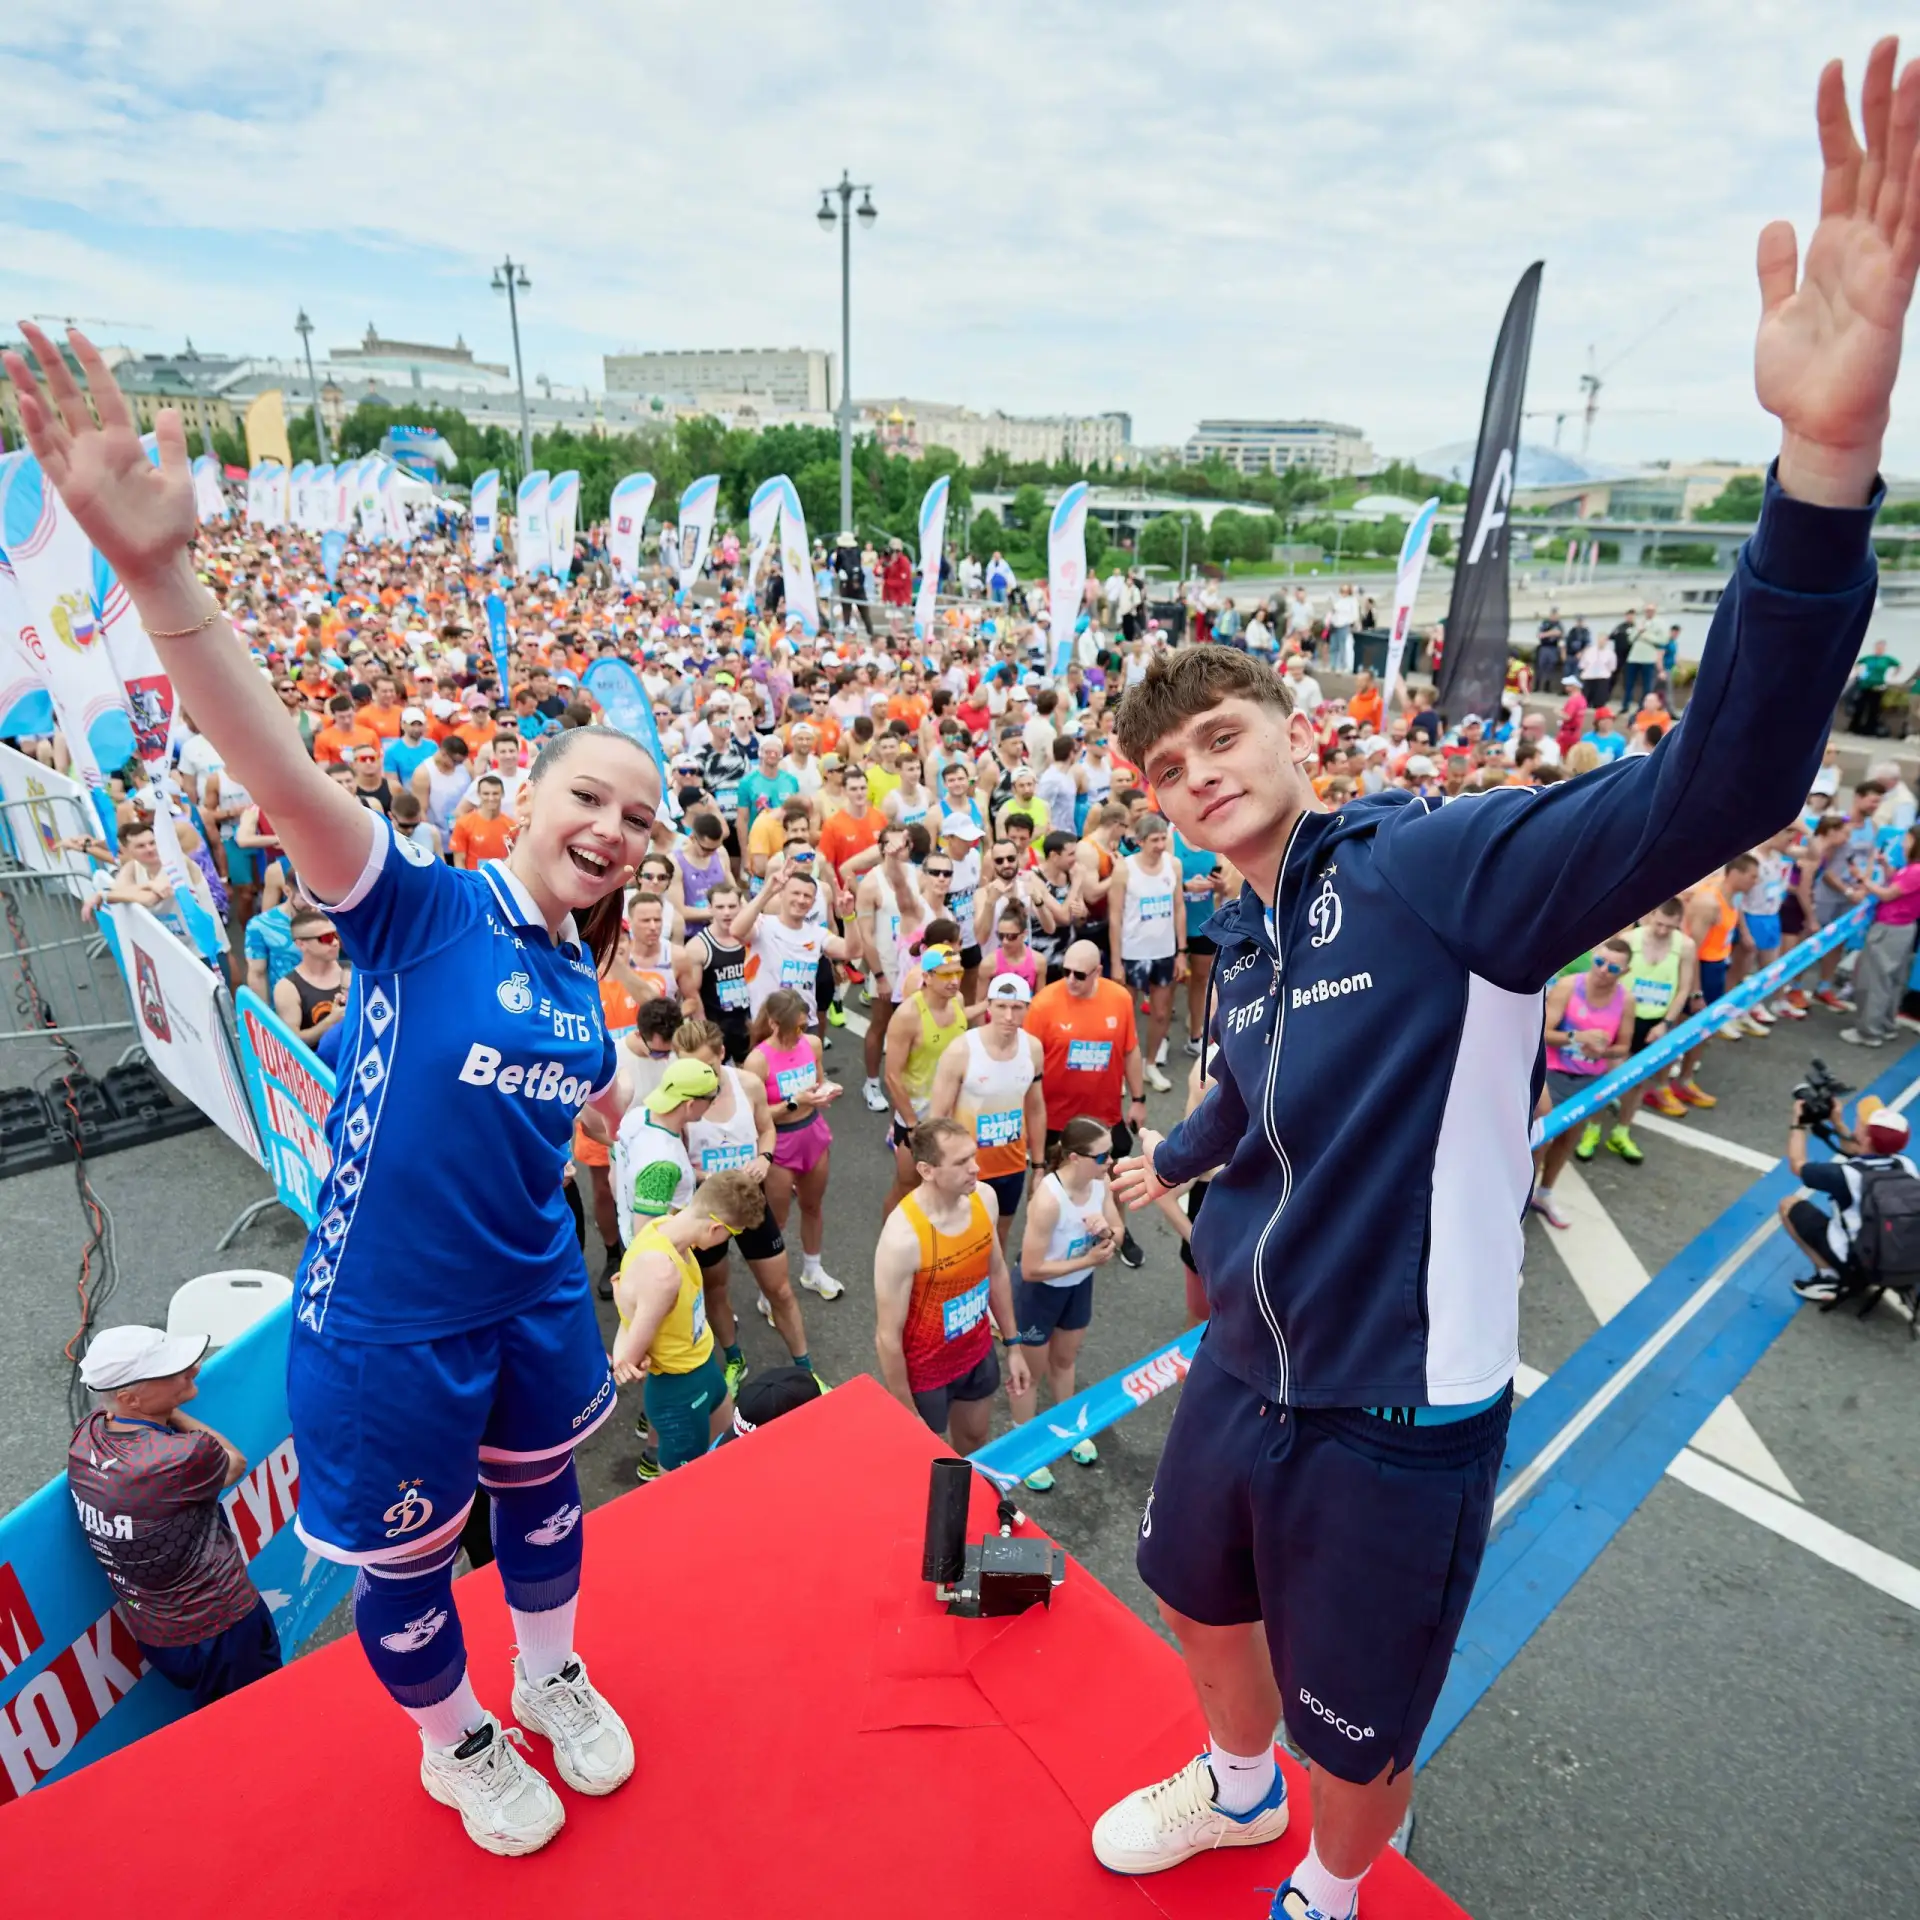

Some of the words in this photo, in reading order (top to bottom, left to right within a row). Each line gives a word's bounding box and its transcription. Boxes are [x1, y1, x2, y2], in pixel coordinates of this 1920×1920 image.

[1292, 971, 1373, 1009] BetBoom
[553, 1008, 590, 1042] ВТБ
[1235, 996, 1265, 1035] ВТБ
[572, 1381, 611, 1429] BOSCO
[1299, 1687, 1363, 1742] BOSCO
